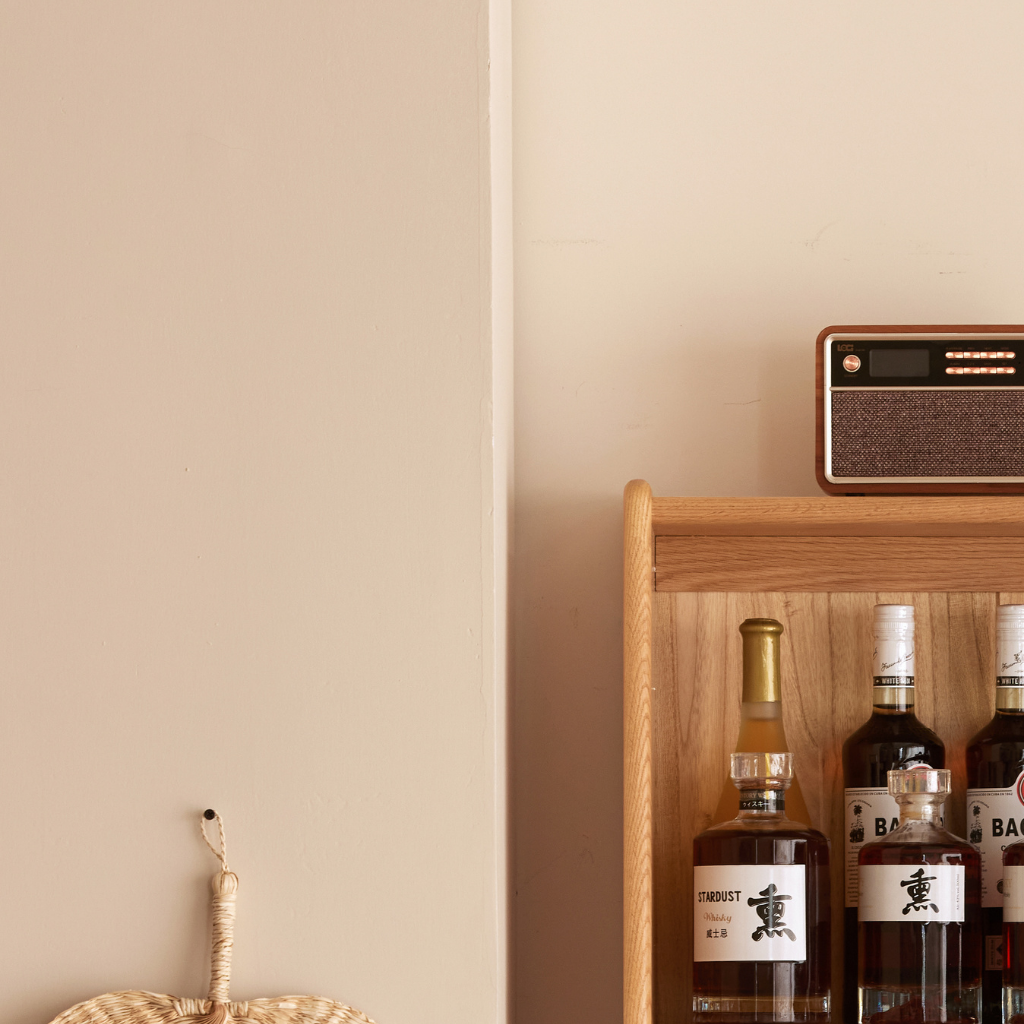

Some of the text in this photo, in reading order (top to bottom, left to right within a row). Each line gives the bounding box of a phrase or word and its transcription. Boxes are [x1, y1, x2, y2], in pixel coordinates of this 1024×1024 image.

[698, 890, 742, 903] STARDUST
[703, 912, 732, 923] Whisky
[706, 928, 728, 939] 威士忌
